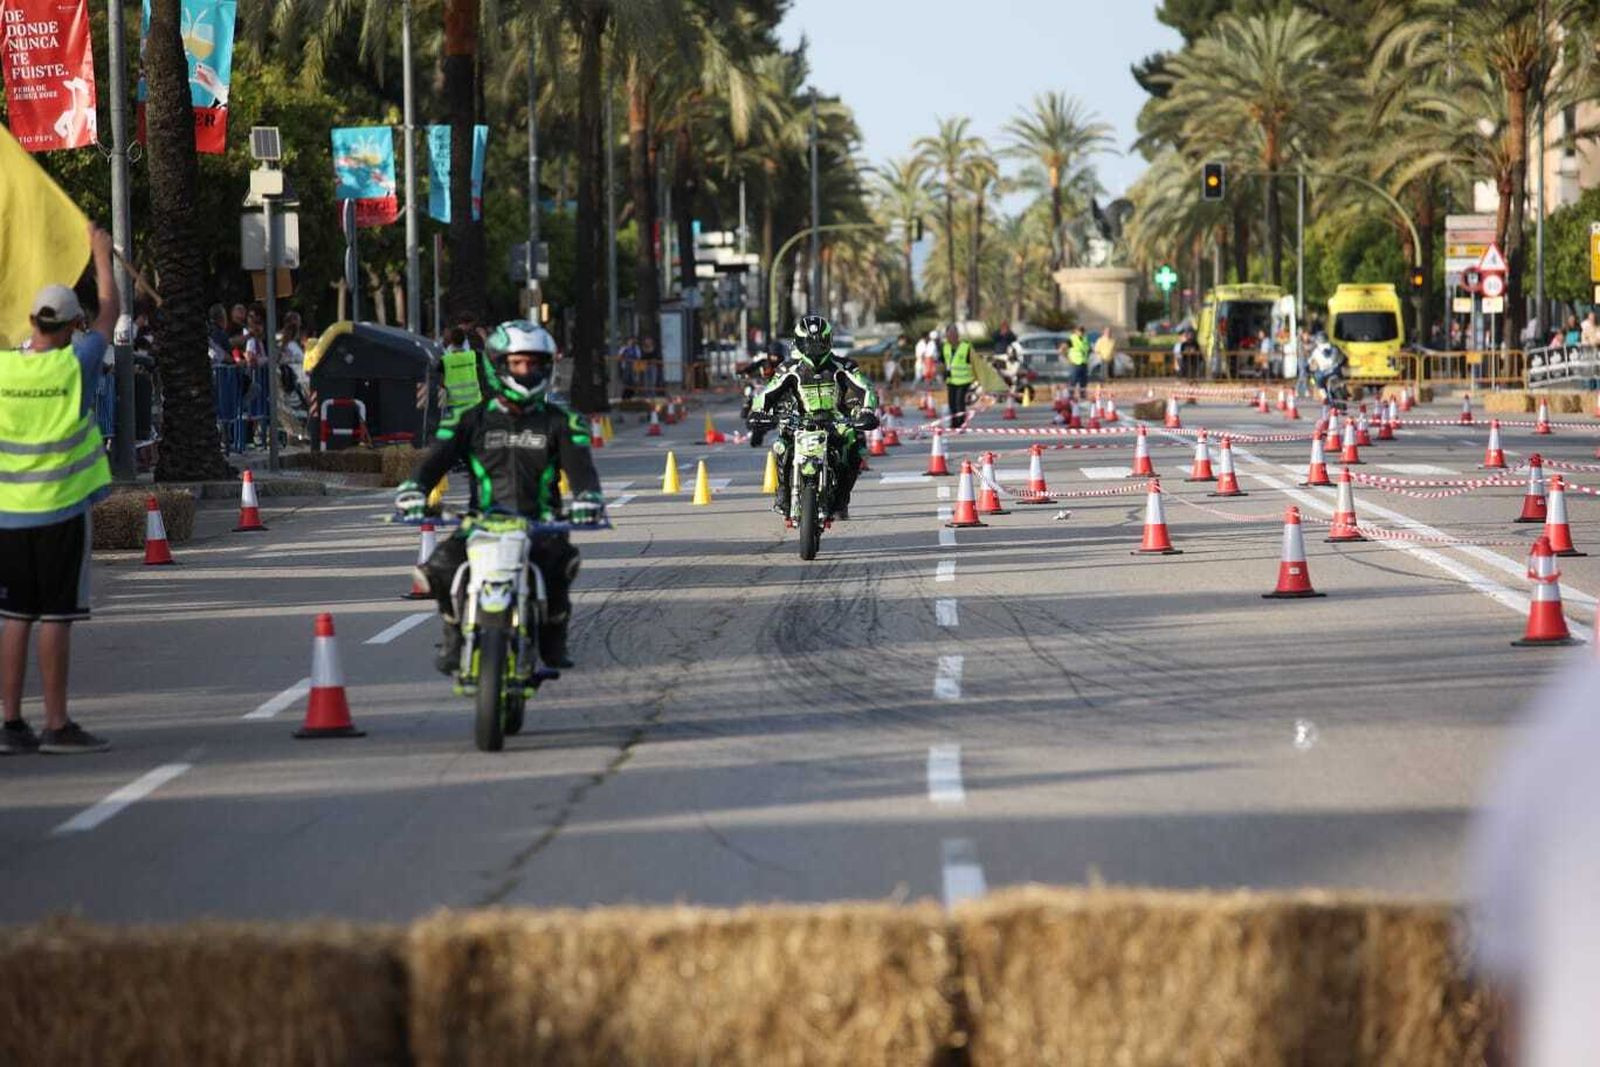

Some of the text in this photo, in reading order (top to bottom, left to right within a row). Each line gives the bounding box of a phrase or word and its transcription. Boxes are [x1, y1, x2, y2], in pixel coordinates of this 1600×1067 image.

[5, 10, 24, 23] DE
[7, 21, 59, 37] DONDE
[8, 36, 59, 52] NUNCA
[9, 52, 30, 66] TE
[12, 63, 70, 80] FUISTE.
